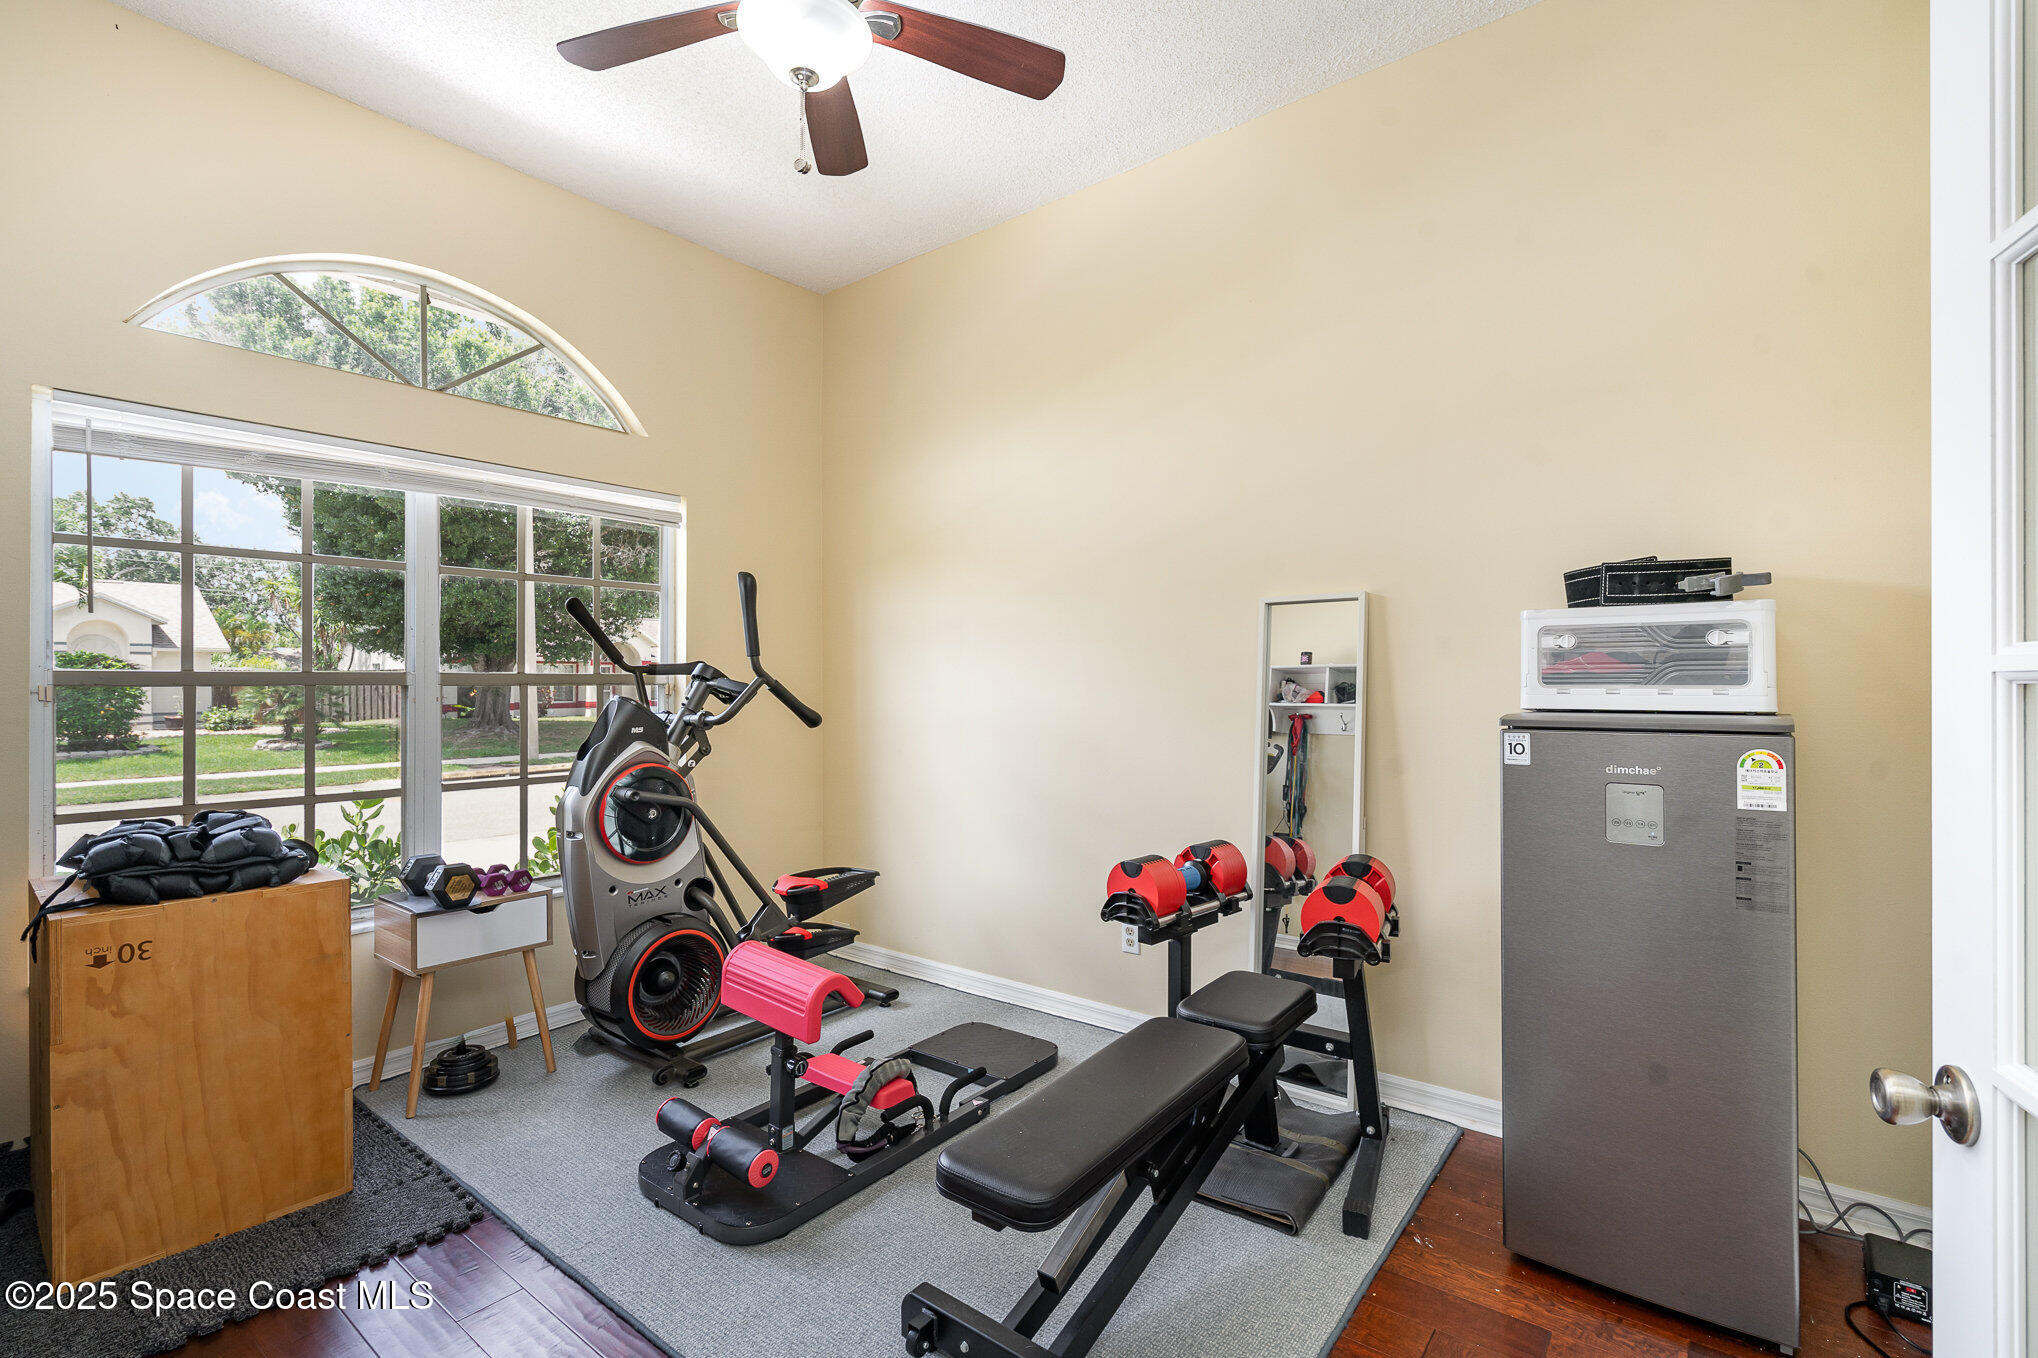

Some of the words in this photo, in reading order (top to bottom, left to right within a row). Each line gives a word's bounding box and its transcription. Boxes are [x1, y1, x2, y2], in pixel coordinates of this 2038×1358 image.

[1508, 742, 1526, 755] 10
[627, 885, 667, 904] MAX
[85, 946, 112, 956] inch
[117, 940, 153, 964] 30
